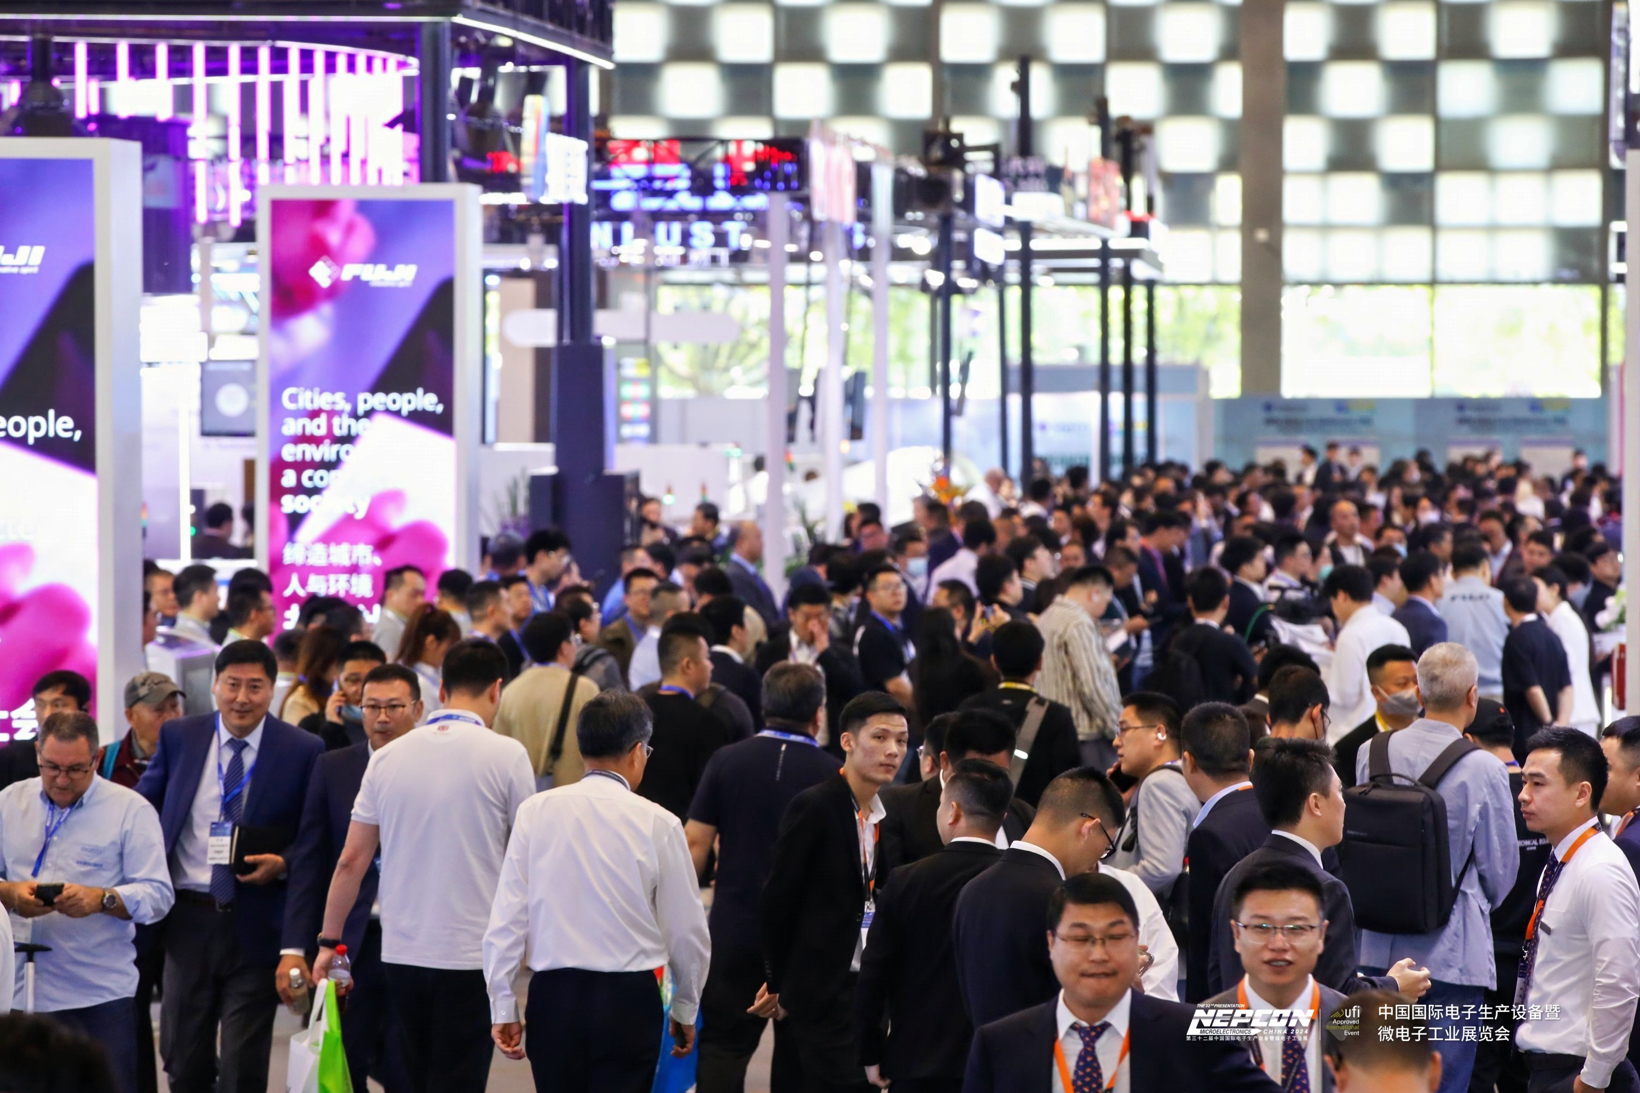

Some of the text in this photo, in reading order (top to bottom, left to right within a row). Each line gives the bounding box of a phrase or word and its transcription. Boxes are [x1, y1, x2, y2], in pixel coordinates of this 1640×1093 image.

[340, 263, 418, 281] FUJI
[281, 387, 444, 417] Cities, people,
[281, 412, 328, 437] and
[280, 469, 297, 488] a
